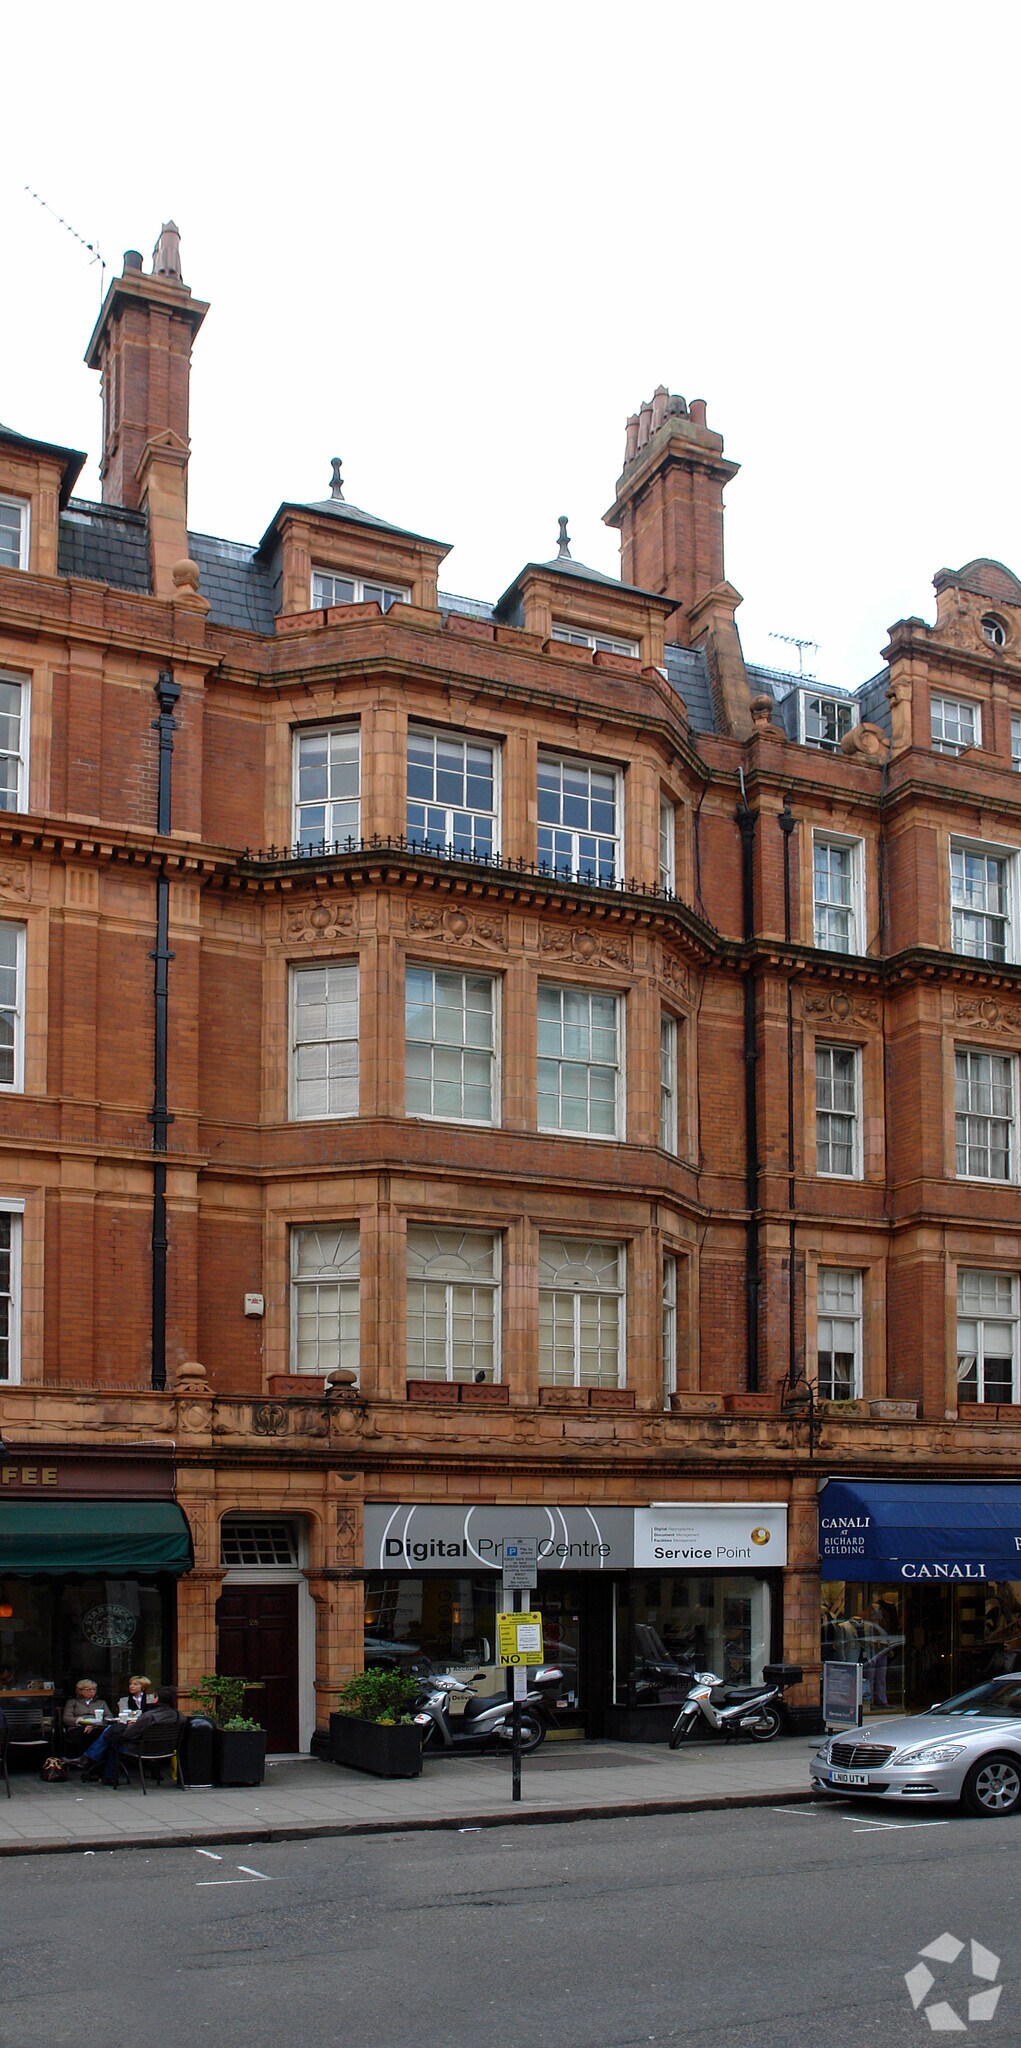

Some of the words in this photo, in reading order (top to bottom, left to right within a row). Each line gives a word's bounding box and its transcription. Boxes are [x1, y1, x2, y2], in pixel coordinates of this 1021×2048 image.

[821, 1517, 870, 1529] CANALI
[824, 1537, 865, 1546] RICHARD
[385, 1538, 468, 1562] Digital
[538, 1539, 611, 1558] Centre
[654, 1546, 712, 1559] Service
[716, 1546, 751, 1558] Point
[824, 1545, 865, 1554] GELDING
[901, 1563, 987, 1578] CANALI
[90, 1633, 129, 1645] COFFEE
[500, 1655, 520, 1665] NO
[849, 1774, 866, 1784] UTW
